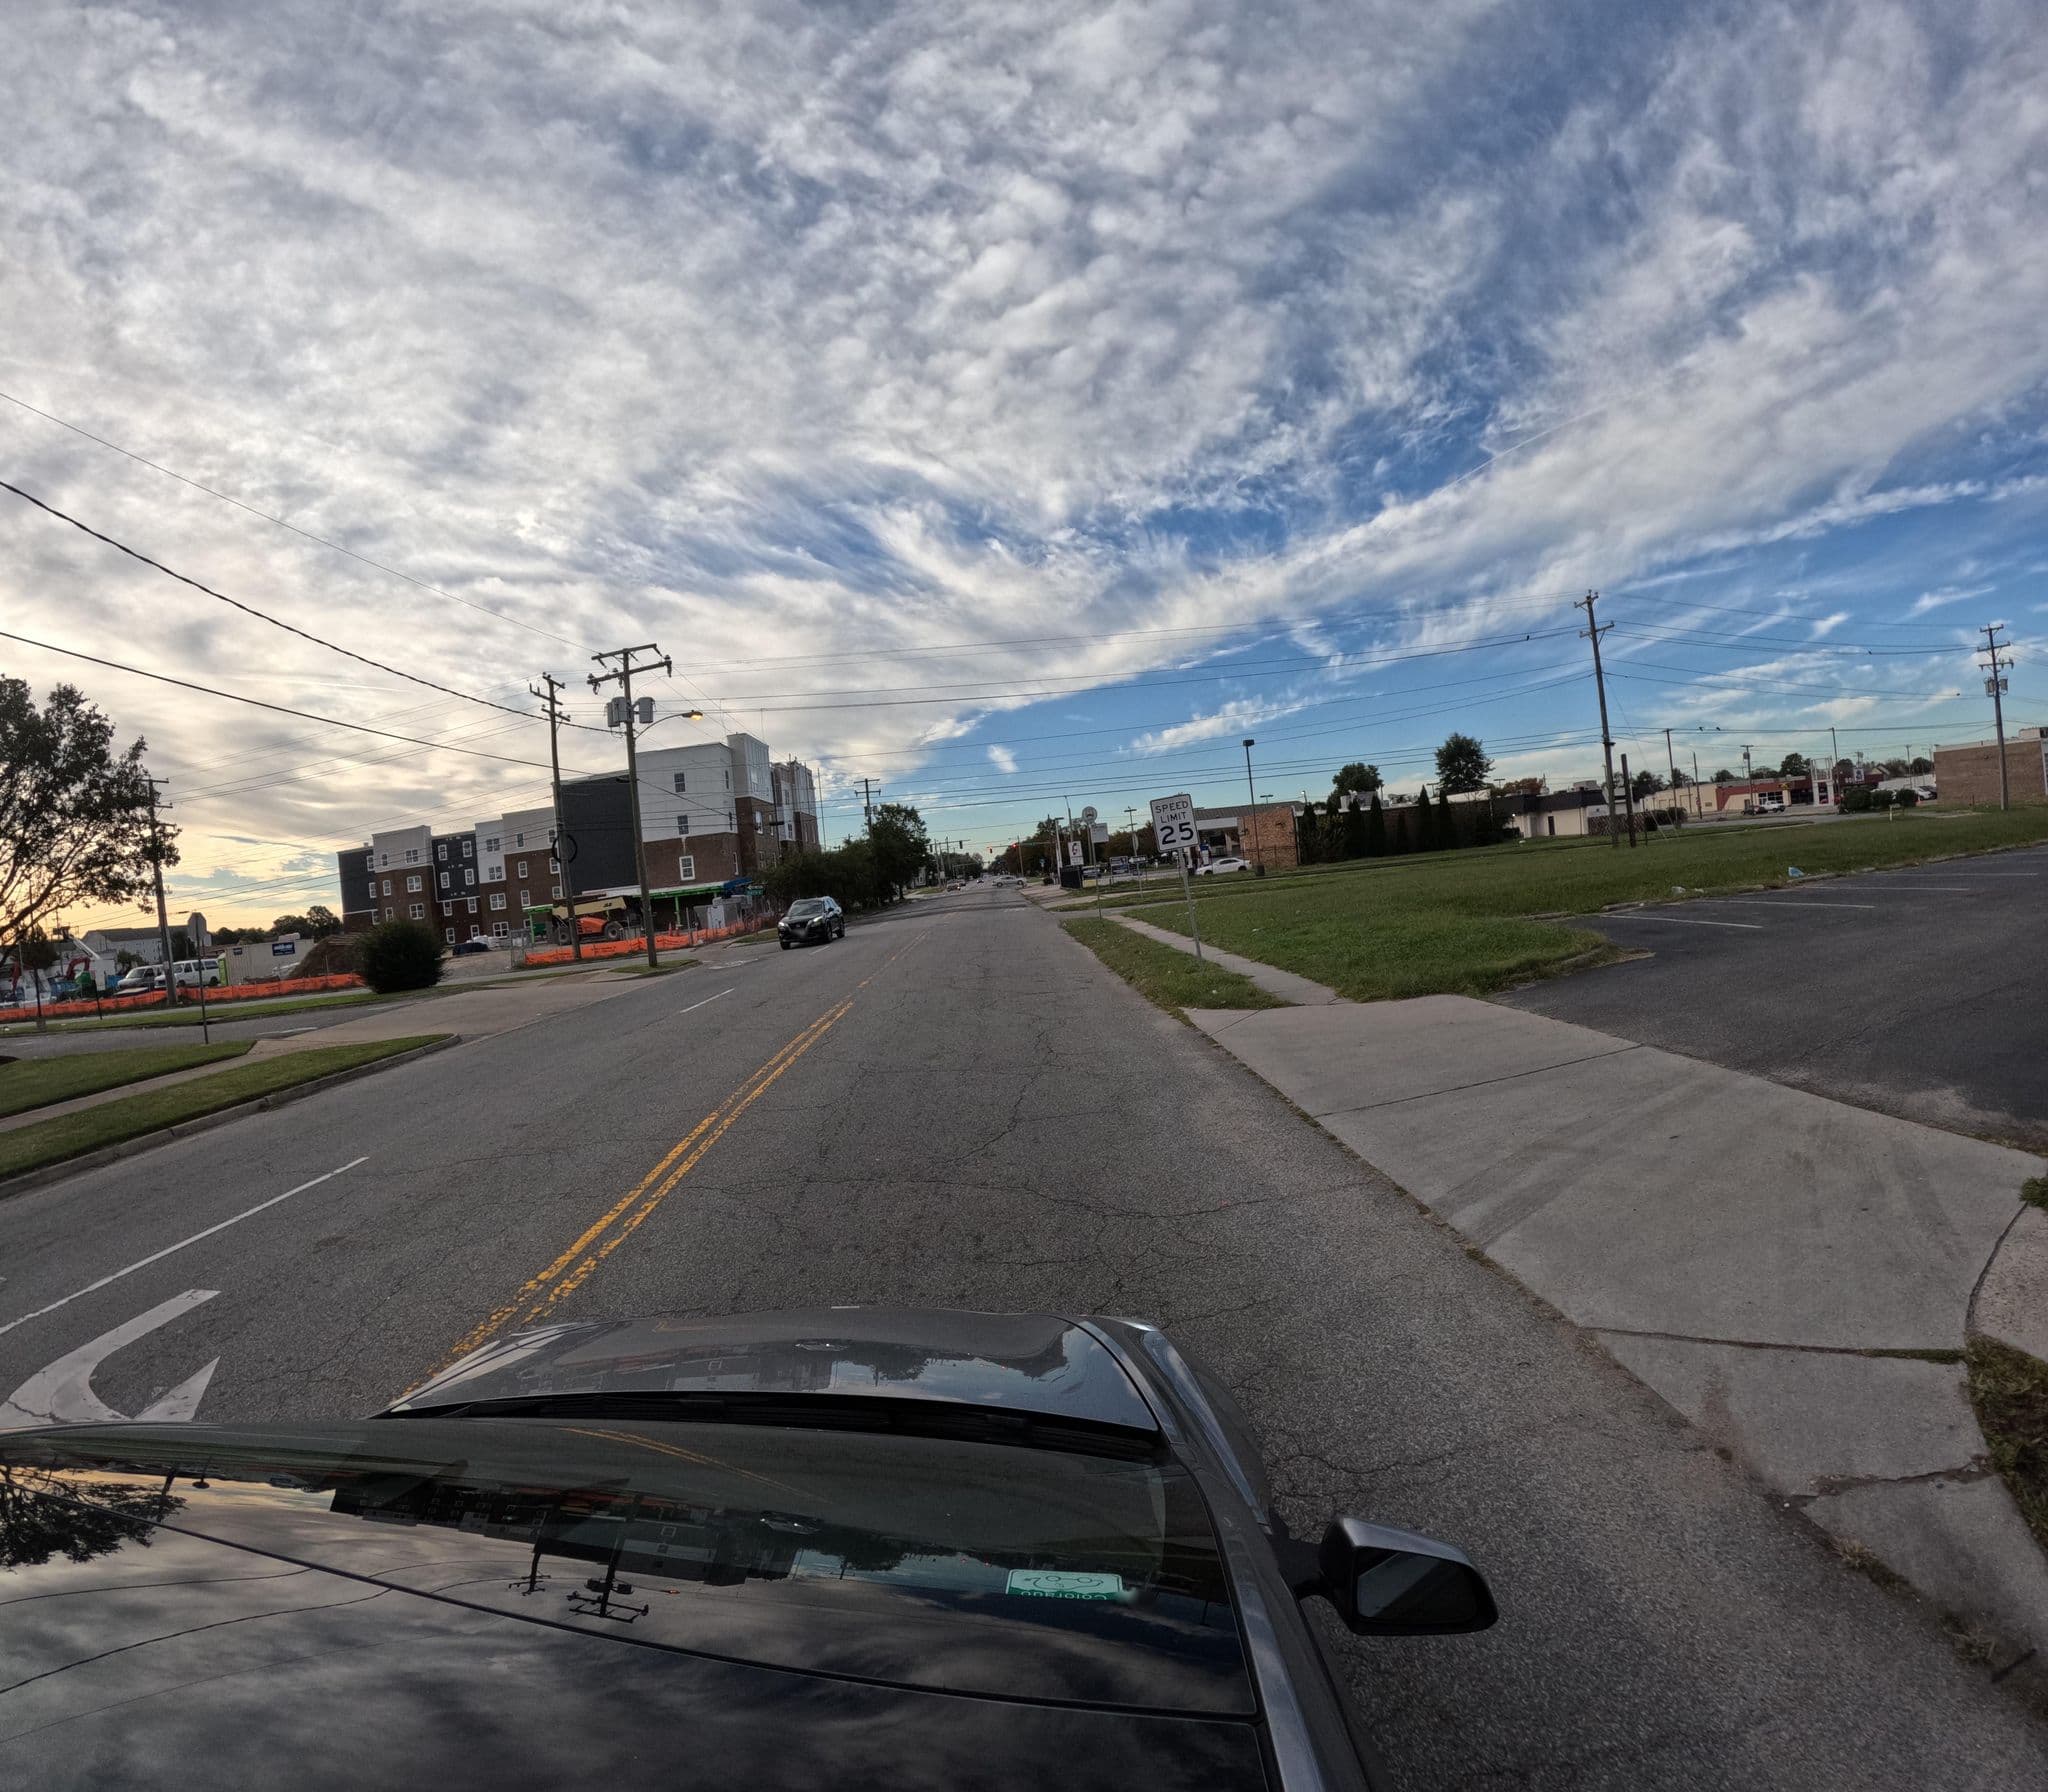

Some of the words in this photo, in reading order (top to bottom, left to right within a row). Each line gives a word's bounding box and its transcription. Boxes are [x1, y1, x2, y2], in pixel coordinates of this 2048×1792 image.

[1155, 801, 1188, 813] SPEED
[1160, 811, 1186, 823] LIMIT
[1160, 822, 1194, 845] 25
